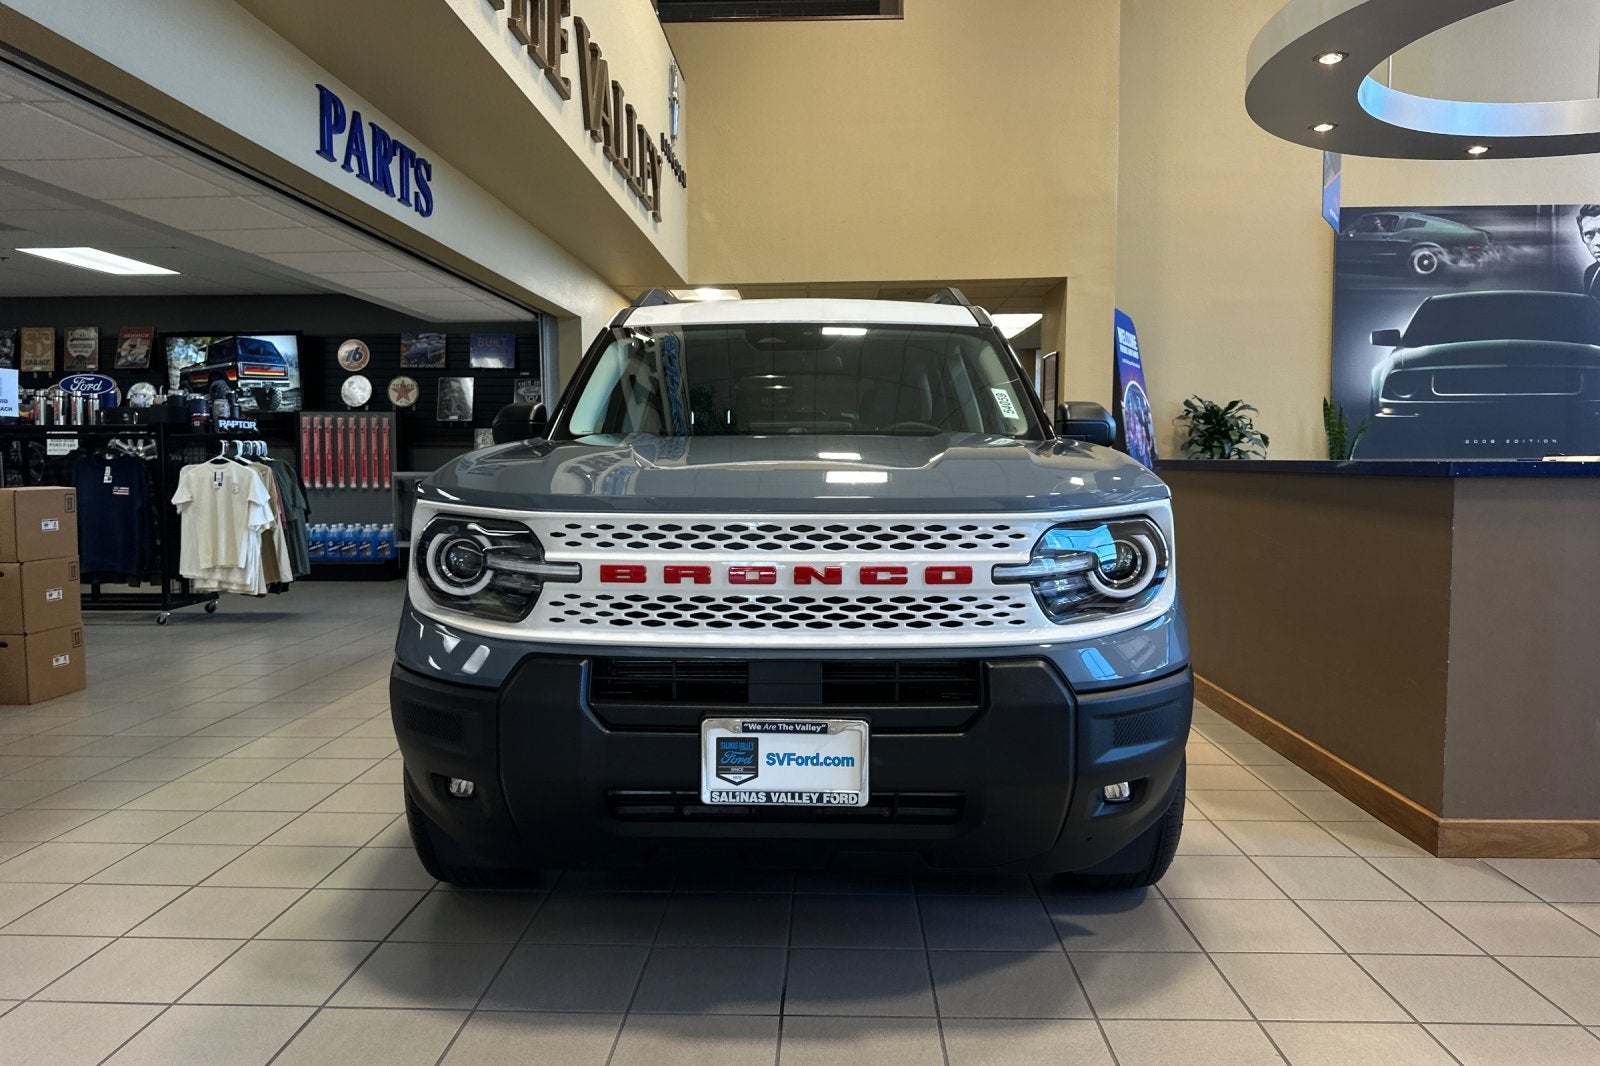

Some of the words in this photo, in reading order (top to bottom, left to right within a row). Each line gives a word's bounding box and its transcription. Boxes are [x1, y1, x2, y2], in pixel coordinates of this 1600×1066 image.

[487, 0, 571, 101] HE
[574, 16, 663, 222] VALLEY
[315, 83, 434, 218] PARTS
[477, 337, 508, 347] BUILT
[344, 346, 363, 363] 76
[70, 376, 103, 391] Ford
[995, 392, 1015, 414] 54059
[218, 419, 258, 431] RAPTOR
[599, 563, 973, 585] BRONCO
[763, 723, 777, 731] Are
[720, 751, 754, 765] Ford
[765, 752, 855, 767] SVFord.com
[711, 791, 767, 803] SALINAS
[769, 792, 820, 804] VALLEY
[822, 793, 859, 805] FORD
